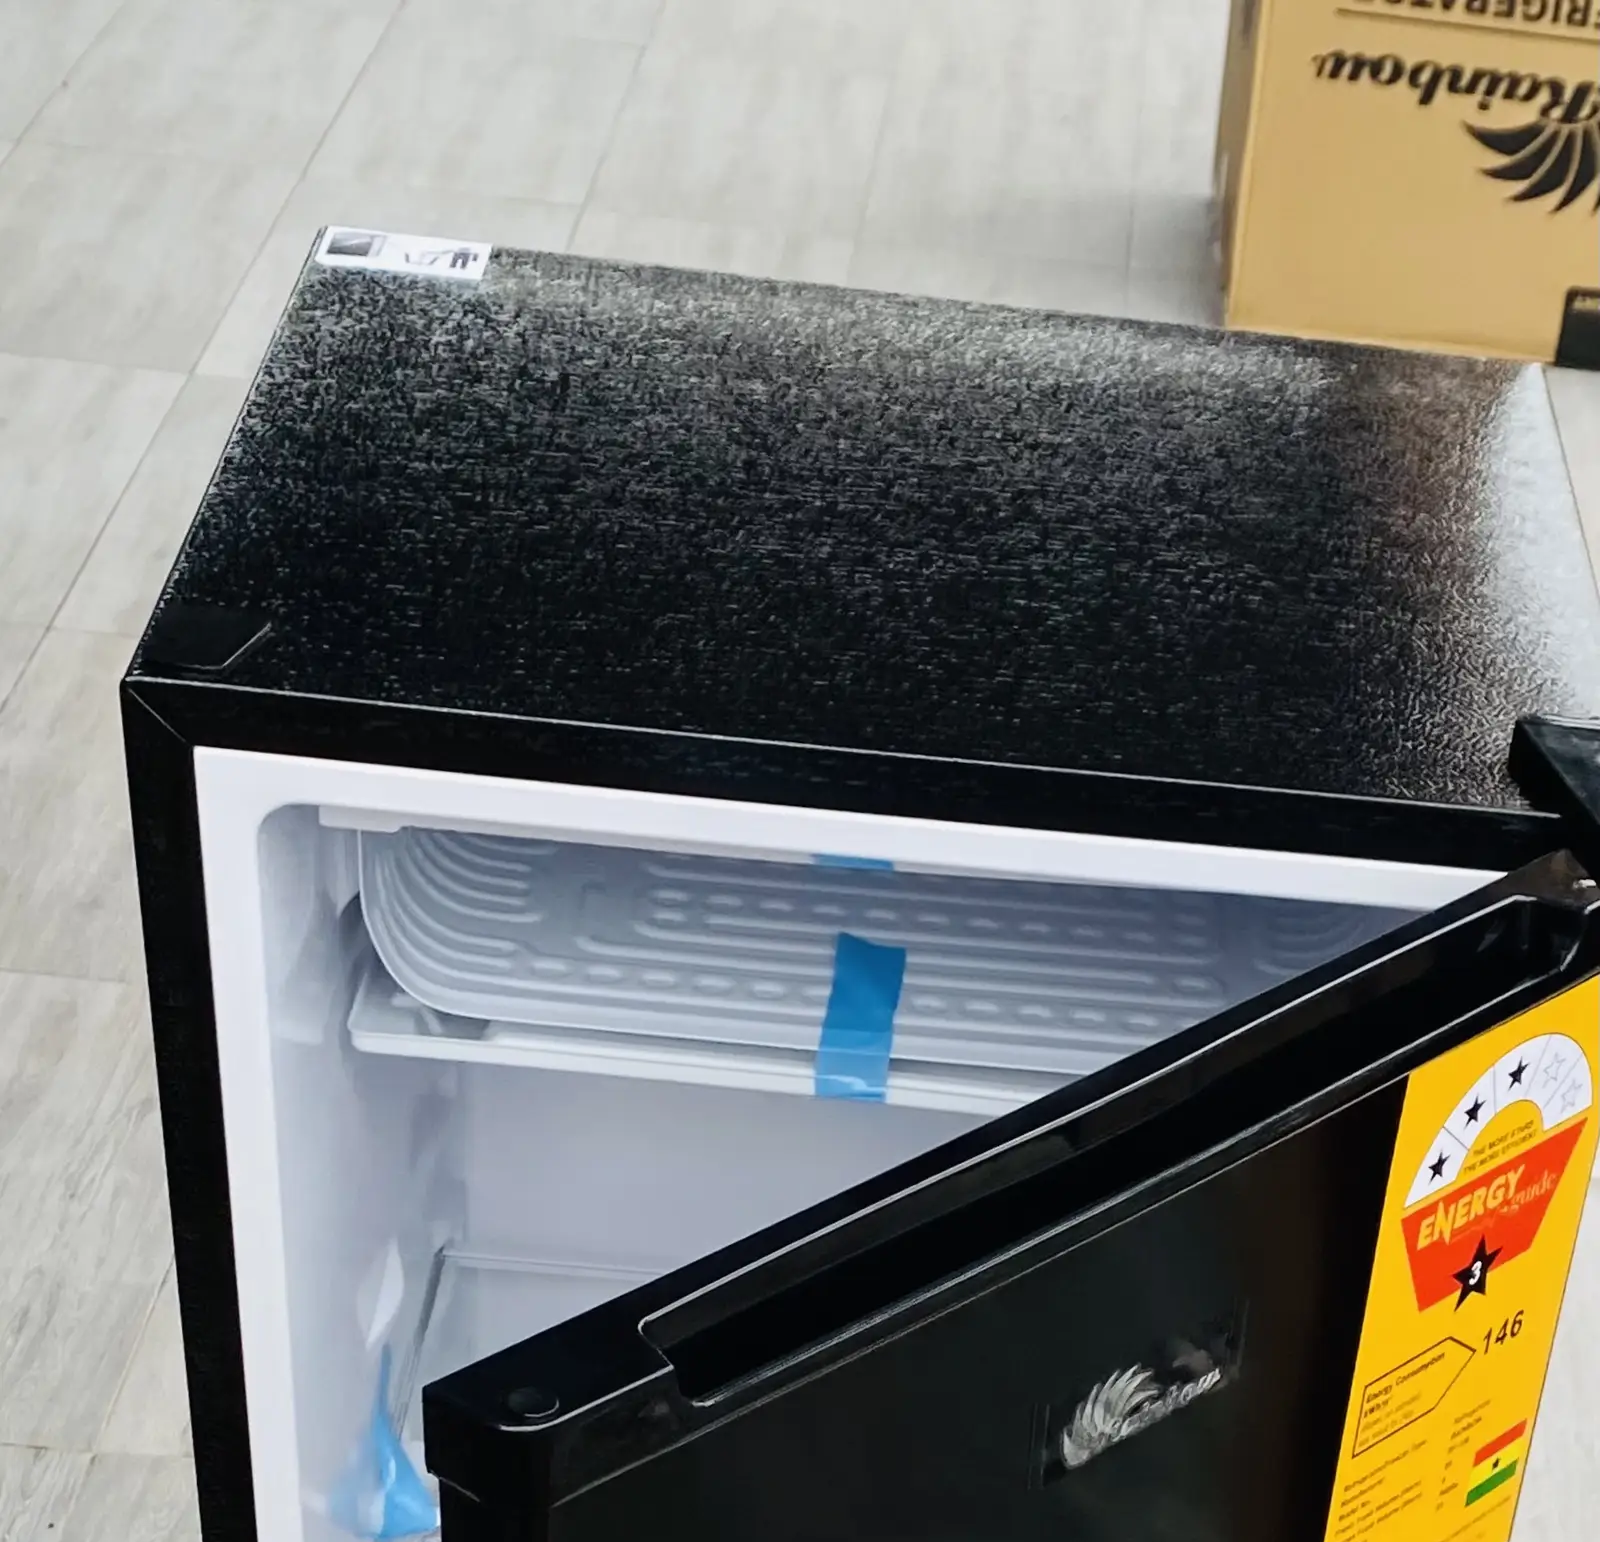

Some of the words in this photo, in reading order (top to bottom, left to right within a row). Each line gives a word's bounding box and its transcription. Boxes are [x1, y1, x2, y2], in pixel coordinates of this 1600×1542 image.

[1311, 49, 1600, 123] Rainbow
[1417, 1164, 1525, 1251] ENERGY
[1468, 1261, 1482, 1286] 3
[1483, 1310, 1524, 1355] 146
